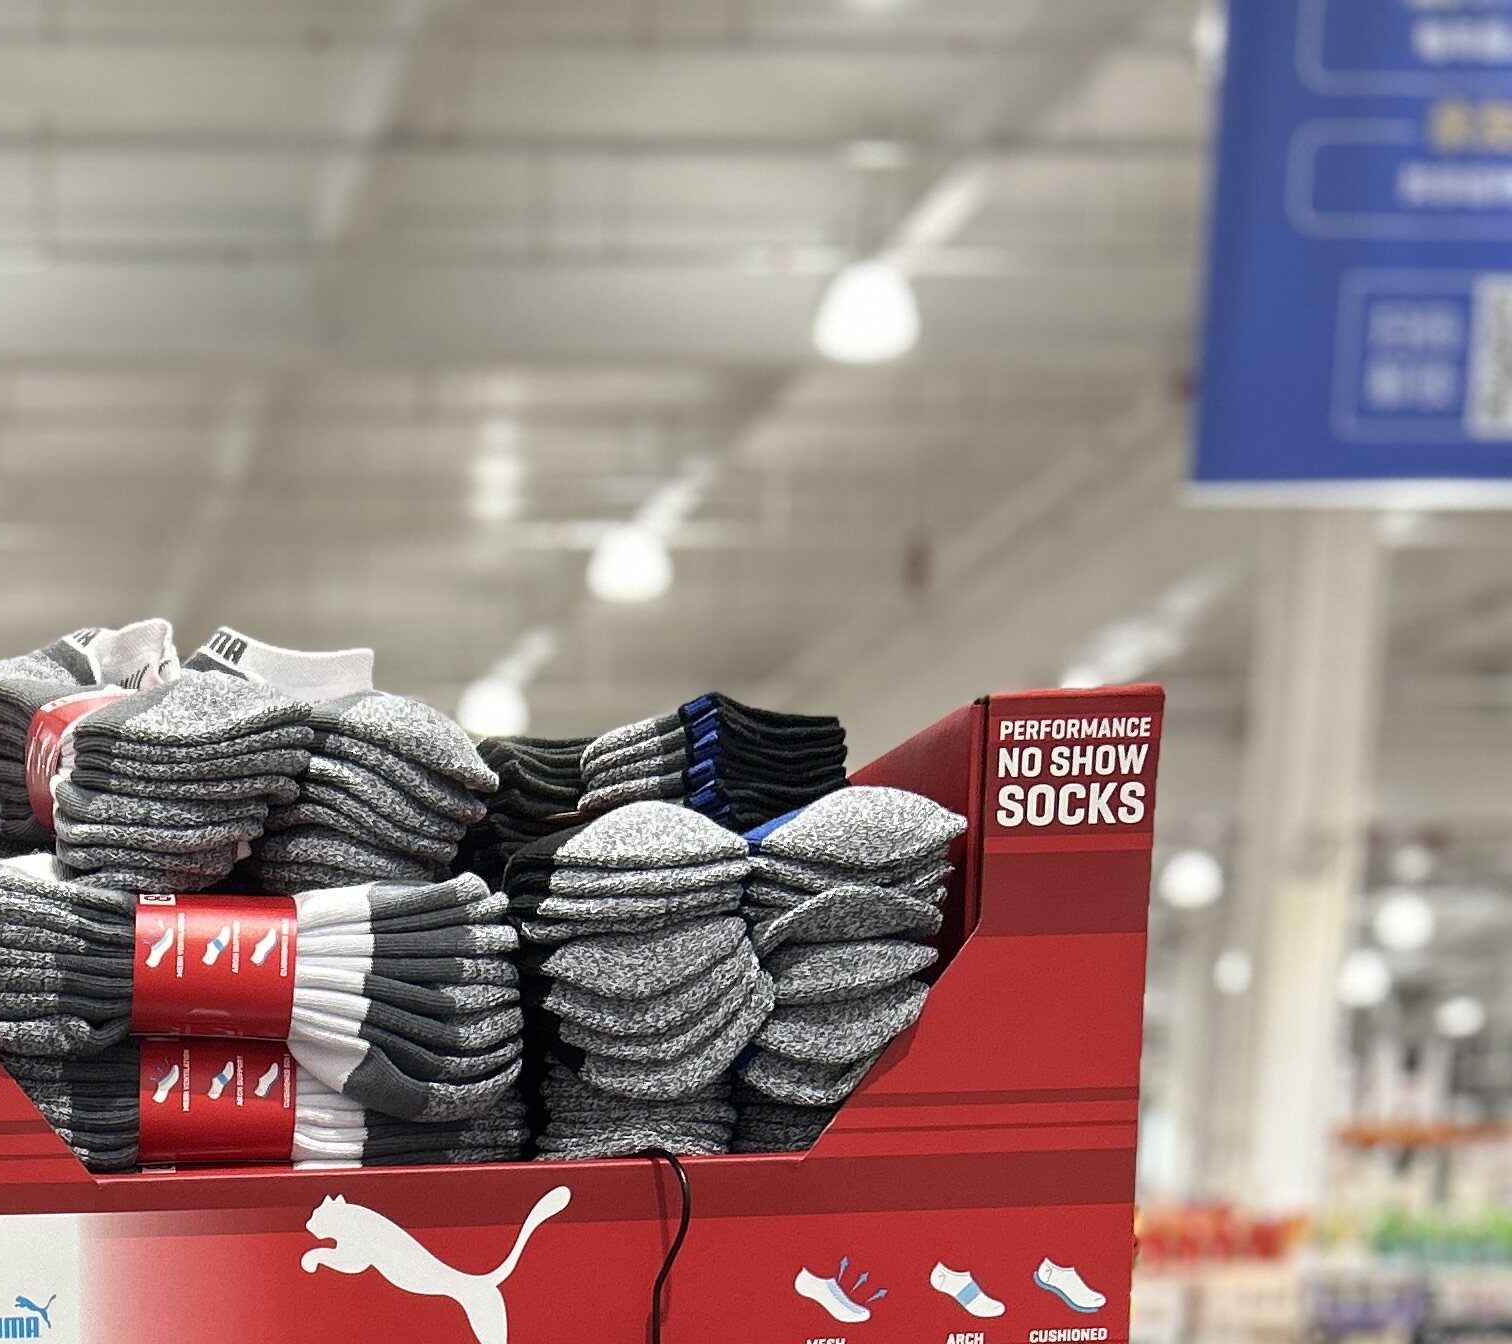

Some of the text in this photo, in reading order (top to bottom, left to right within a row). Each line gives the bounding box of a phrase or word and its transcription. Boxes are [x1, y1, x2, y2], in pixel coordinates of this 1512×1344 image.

[999, 716, 1152, 741] PERFORMANCE
[997, 743, 1149, 778] NO SHOW
[996, 781, 1145, 827] SOCKS
[1029, 1328, 1108, 1343] CUSHIONED
